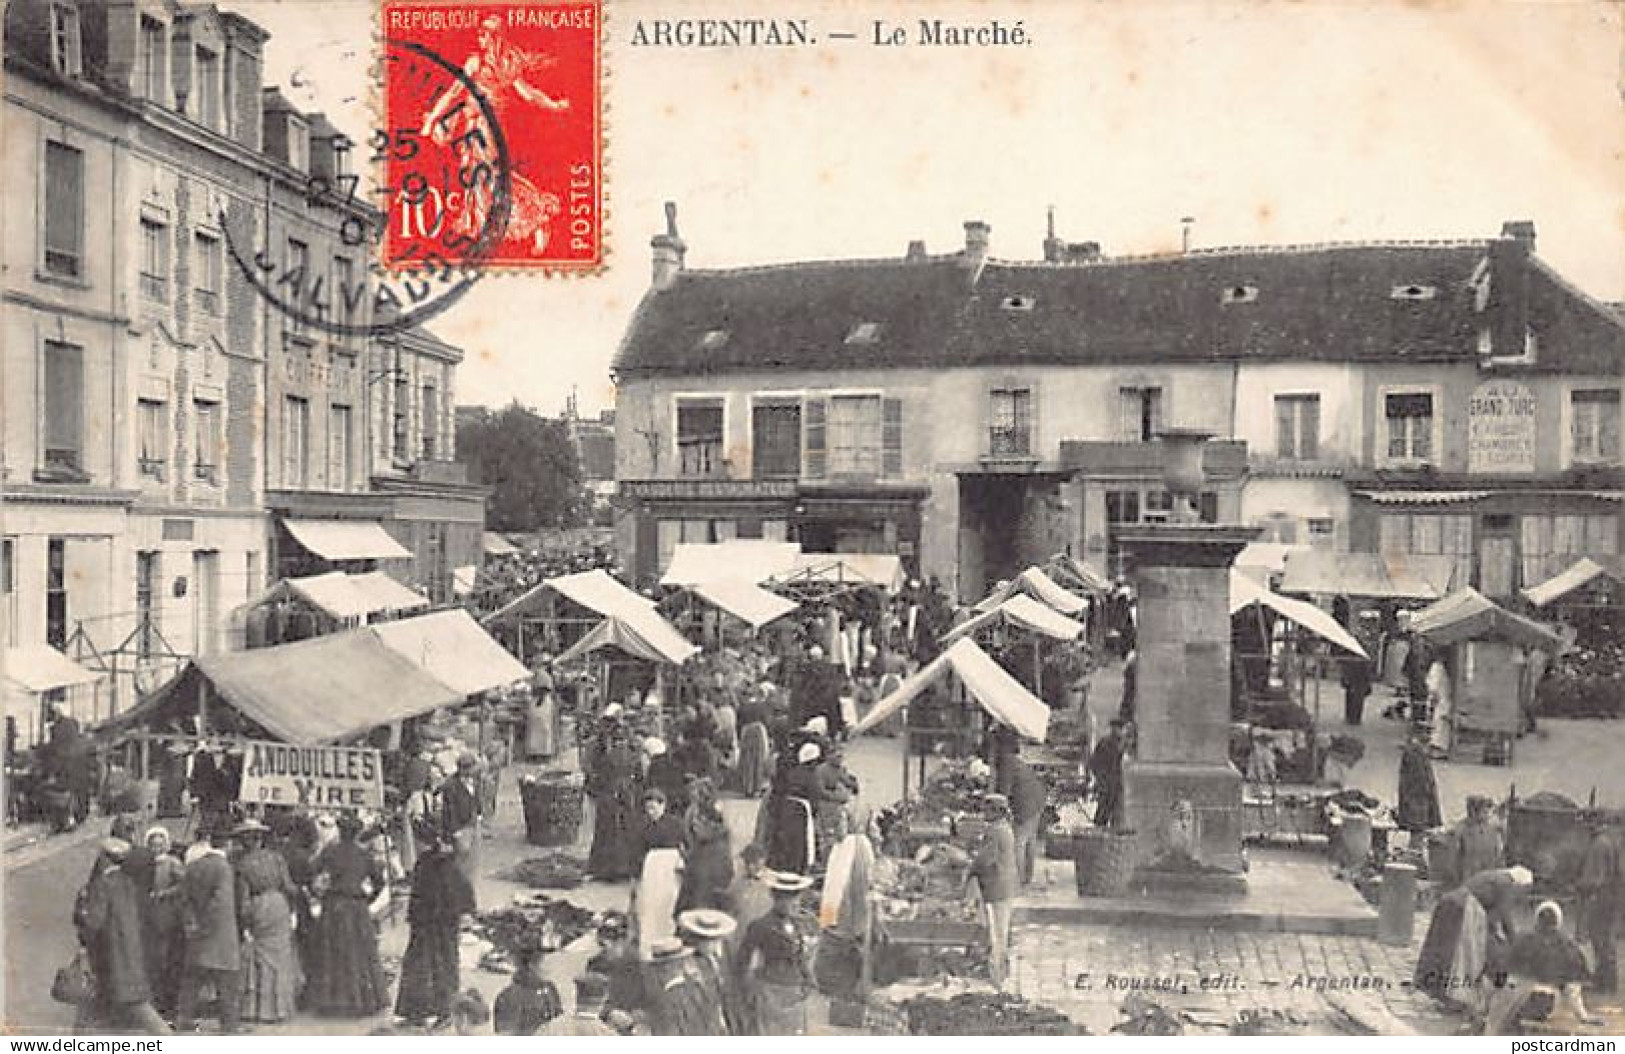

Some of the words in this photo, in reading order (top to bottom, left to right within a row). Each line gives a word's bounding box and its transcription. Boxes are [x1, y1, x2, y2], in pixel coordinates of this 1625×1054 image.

[570, 162, 591, 250] POSTES
[1469, 398, 1503, 417] GRAND
[247, 744, 375, 780] ANDOUILLES
[259, 786, 282, 800] DE
[293, 779, 366, 804] VIRE
